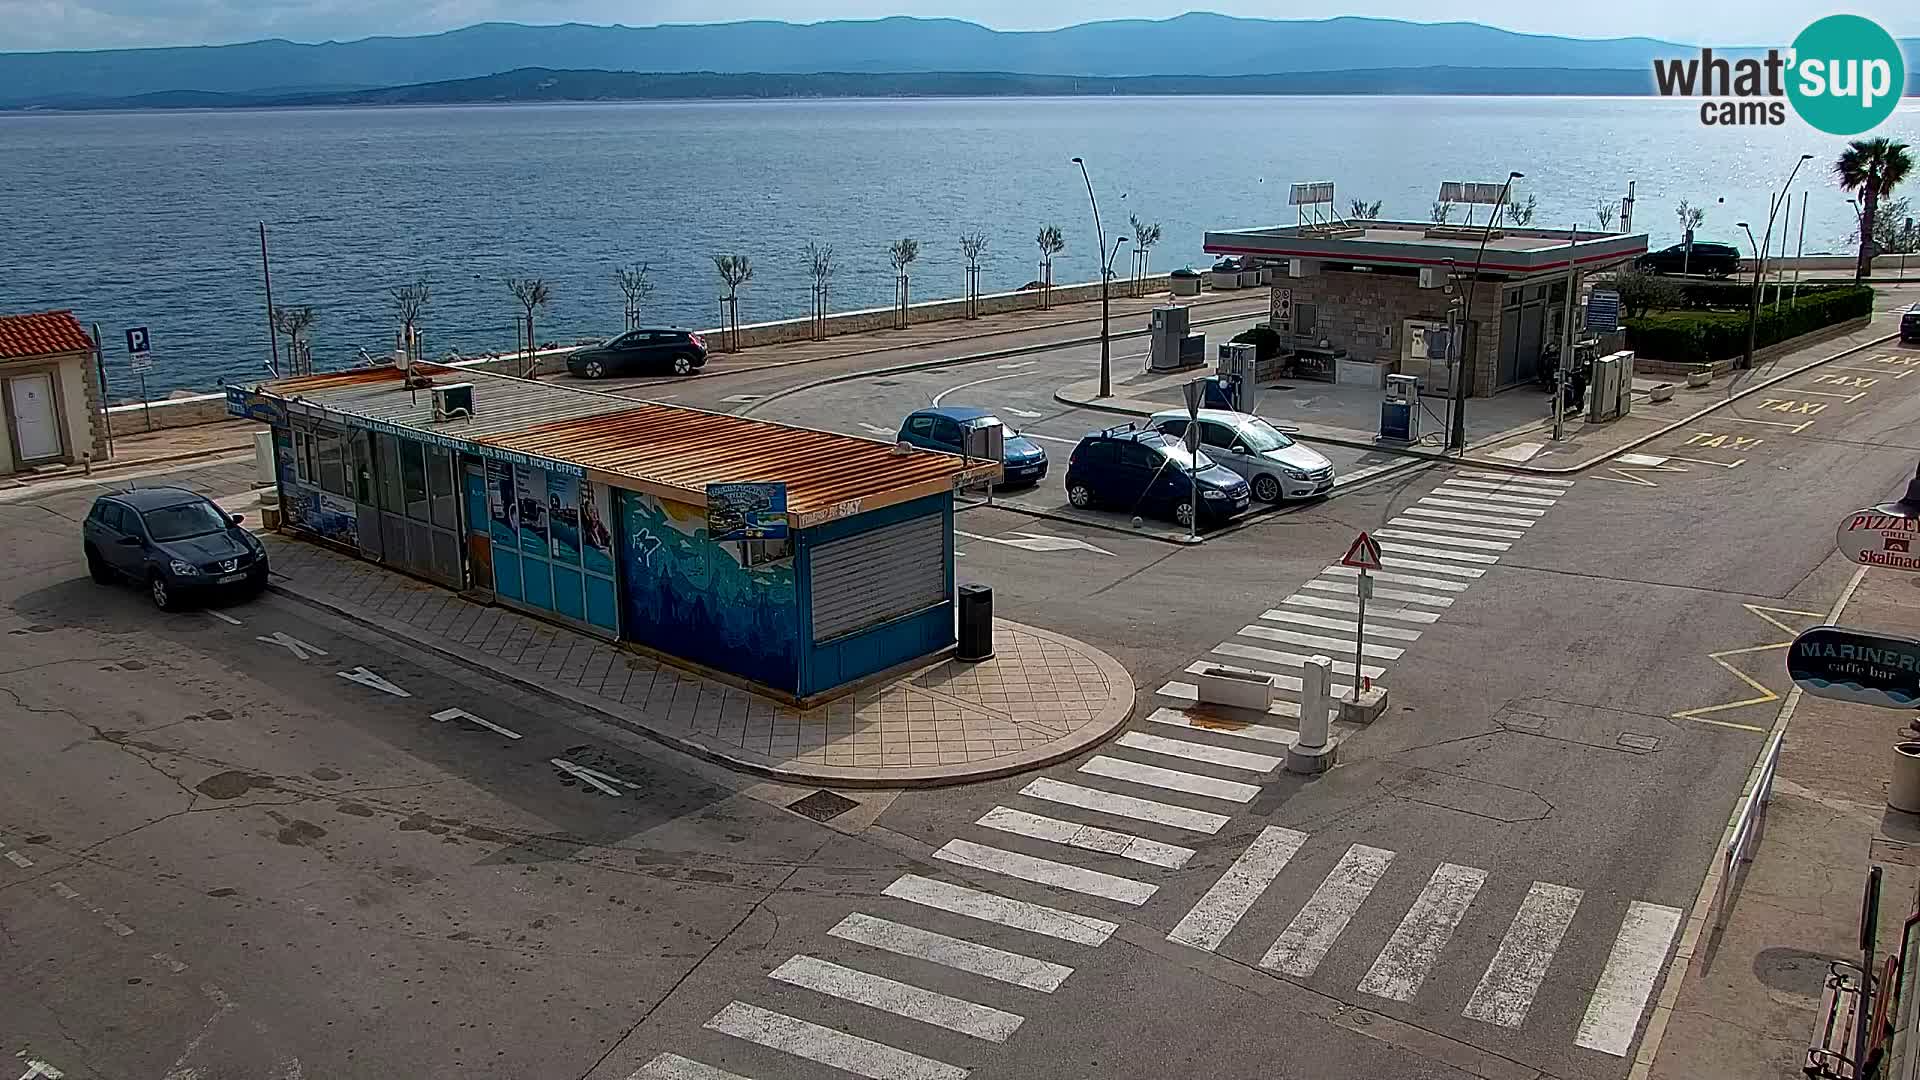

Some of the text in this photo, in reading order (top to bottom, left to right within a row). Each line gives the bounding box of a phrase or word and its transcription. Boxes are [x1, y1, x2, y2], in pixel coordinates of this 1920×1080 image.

[131, 331, 144, 350] P
[1813, 374, 1879, 388] TAXI
[1756, 399, 1828, 415] TAXI
[1684, 433, 1764, 451] TAXI
[479, 446, 494, 458] BUS
[495, 450, 527, 464] STATION
[529, 457, 555, 471] TICKET
[556, 462, 583, 477] OFFICE
[1848, 515, 1920, 533] PIZZE
[1881, 530, 1916, 540] GRILL
[1801, 642, 1920, 673] MARINER
[1870, 665, 1896, 679] bar
